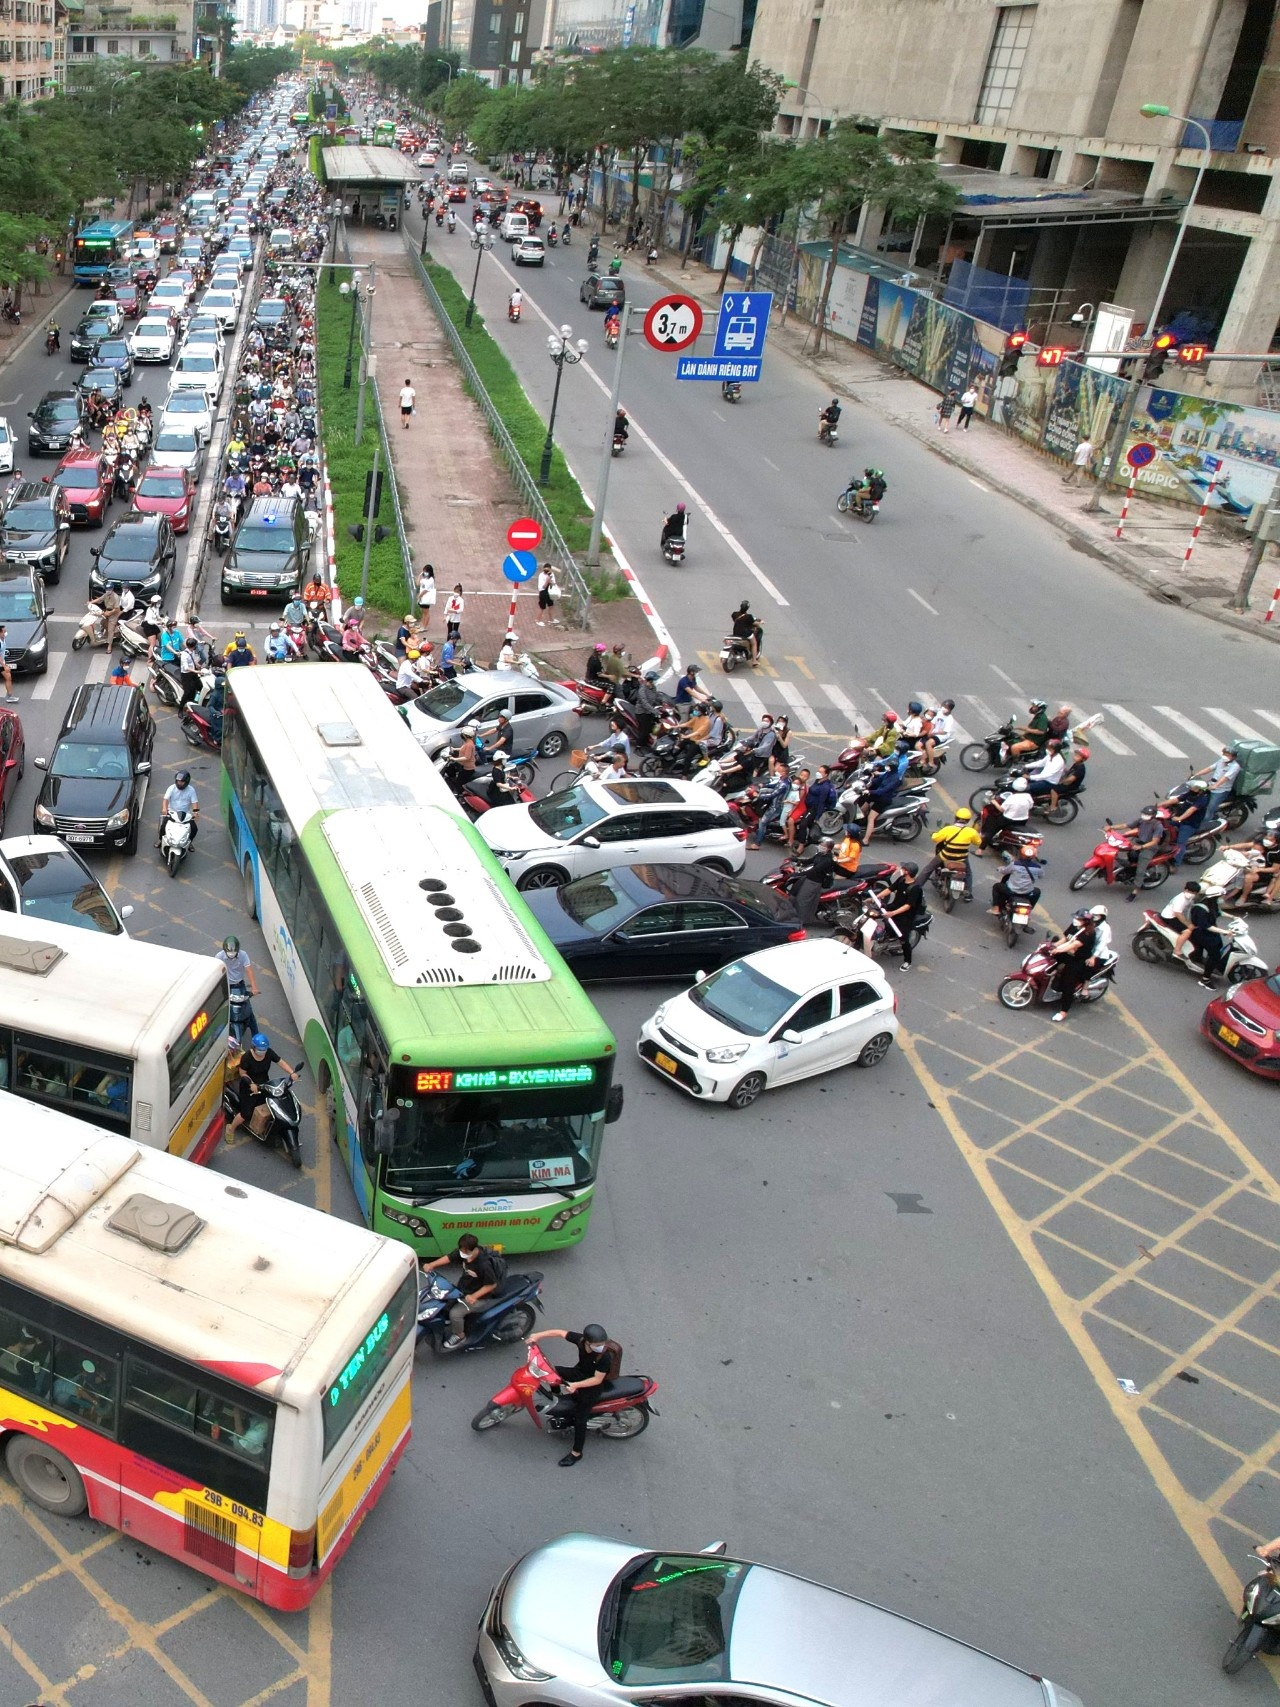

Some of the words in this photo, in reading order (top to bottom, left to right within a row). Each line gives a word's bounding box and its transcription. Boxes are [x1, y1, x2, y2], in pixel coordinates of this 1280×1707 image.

[678, 324, 687, 334] m
[1042, 350, 1062, 364] 47
[1182, 348, 1203, 361] 47
[682, 360, 696, 376] LÀN
[698, 360, 718, 376] DÀNH
[719, 361, 742, 376] RIÊNG
[742, 364, 758, 377] BRT
[1120, 464, 1180, 490] OYMPIC
[416, 1072, 452, 1091] BRT
[531, 1168, 550, 1180] KIM
[204, 1488, 222, 1508] 29B
[231, 1503, 264, 1528] 094.83
